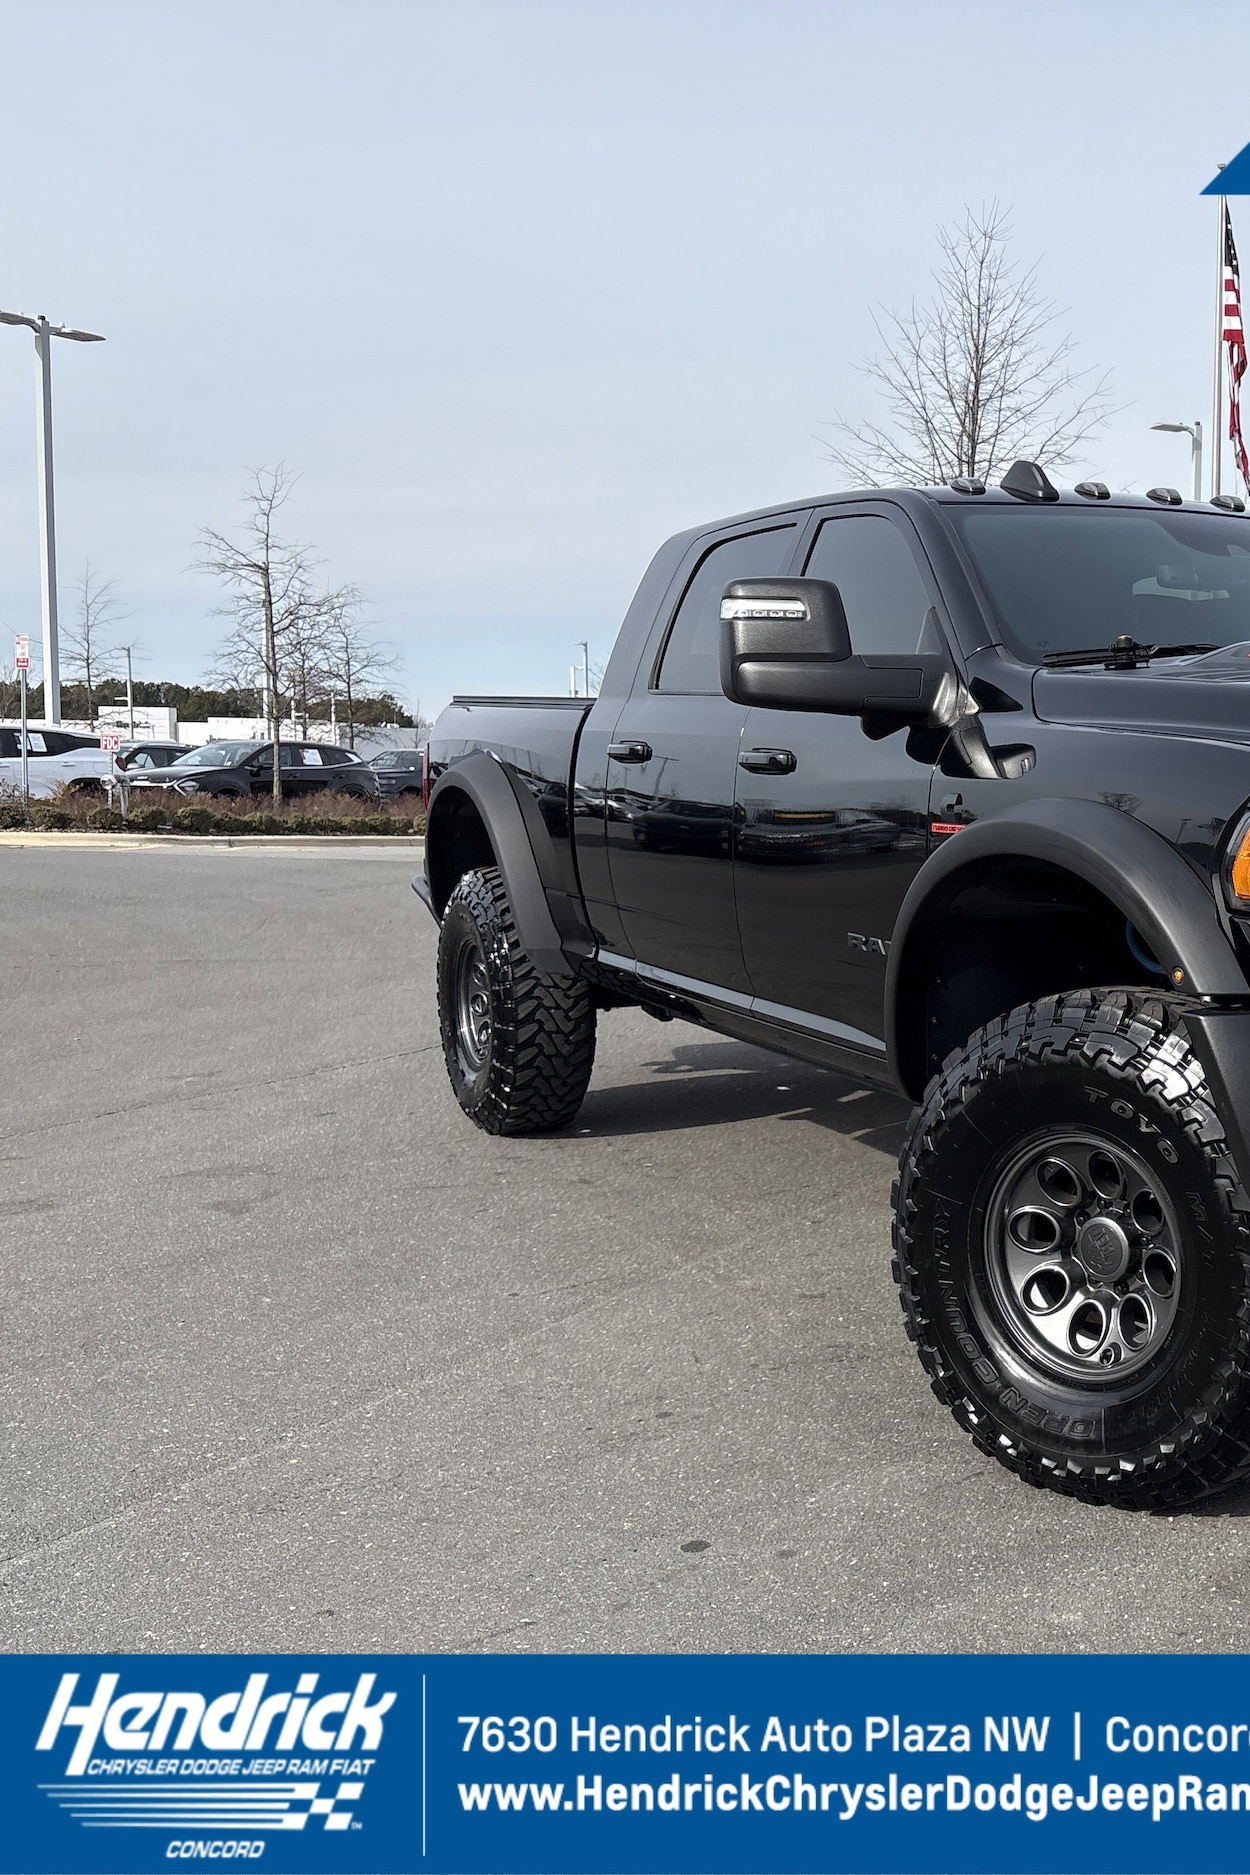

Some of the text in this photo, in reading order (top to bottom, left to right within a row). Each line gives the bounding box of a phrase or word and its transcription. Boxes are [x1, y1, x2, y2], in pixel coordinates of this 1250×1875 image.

[102, 737, 118, 750] FDC
[846, 932, 892, 956] RA
[1083, 1083, 1180, 1164] TOYO
[933, 1197, 1096, 1438] OPEN COUNTRY
